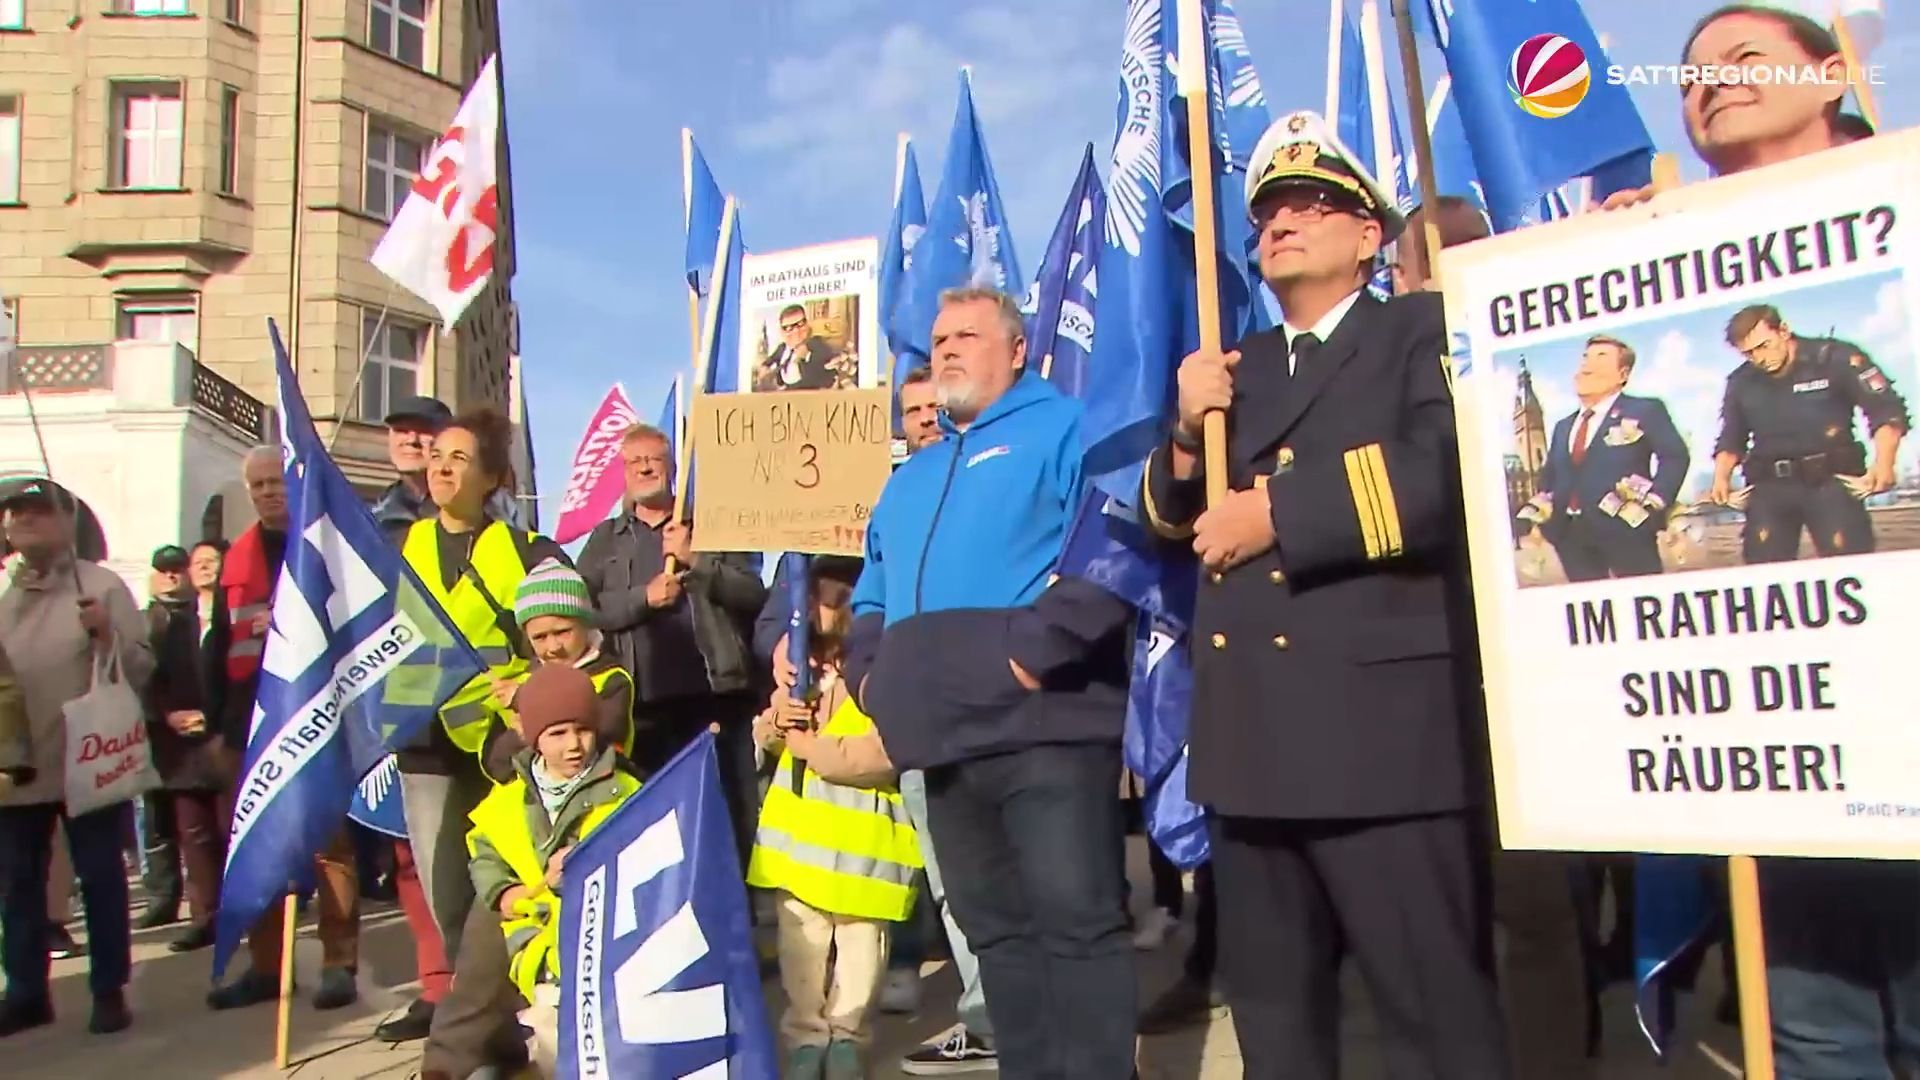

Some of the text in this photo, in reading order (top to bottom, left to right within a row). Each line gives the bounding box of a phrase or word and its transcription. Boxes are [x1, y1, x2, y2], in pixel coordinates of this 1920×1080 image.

[750, 259, 866, 288] IM RATHAUS SIND
[766, 287, 785, 302] DIE
[1489, 205, 1897, 338] GERECHTIGKEIT?
[716, 401, 888, 447] ICH BIN KIND
[794, 443, 820, 489] 3
[1565, 577, 1869, 647] IM RATHAUS
[1621, 661, 1837, 718] SIND DIE
[1629, 734, 1847, 793] RÄUBER!
[580, 879, 601, 1077] Gewerksch
